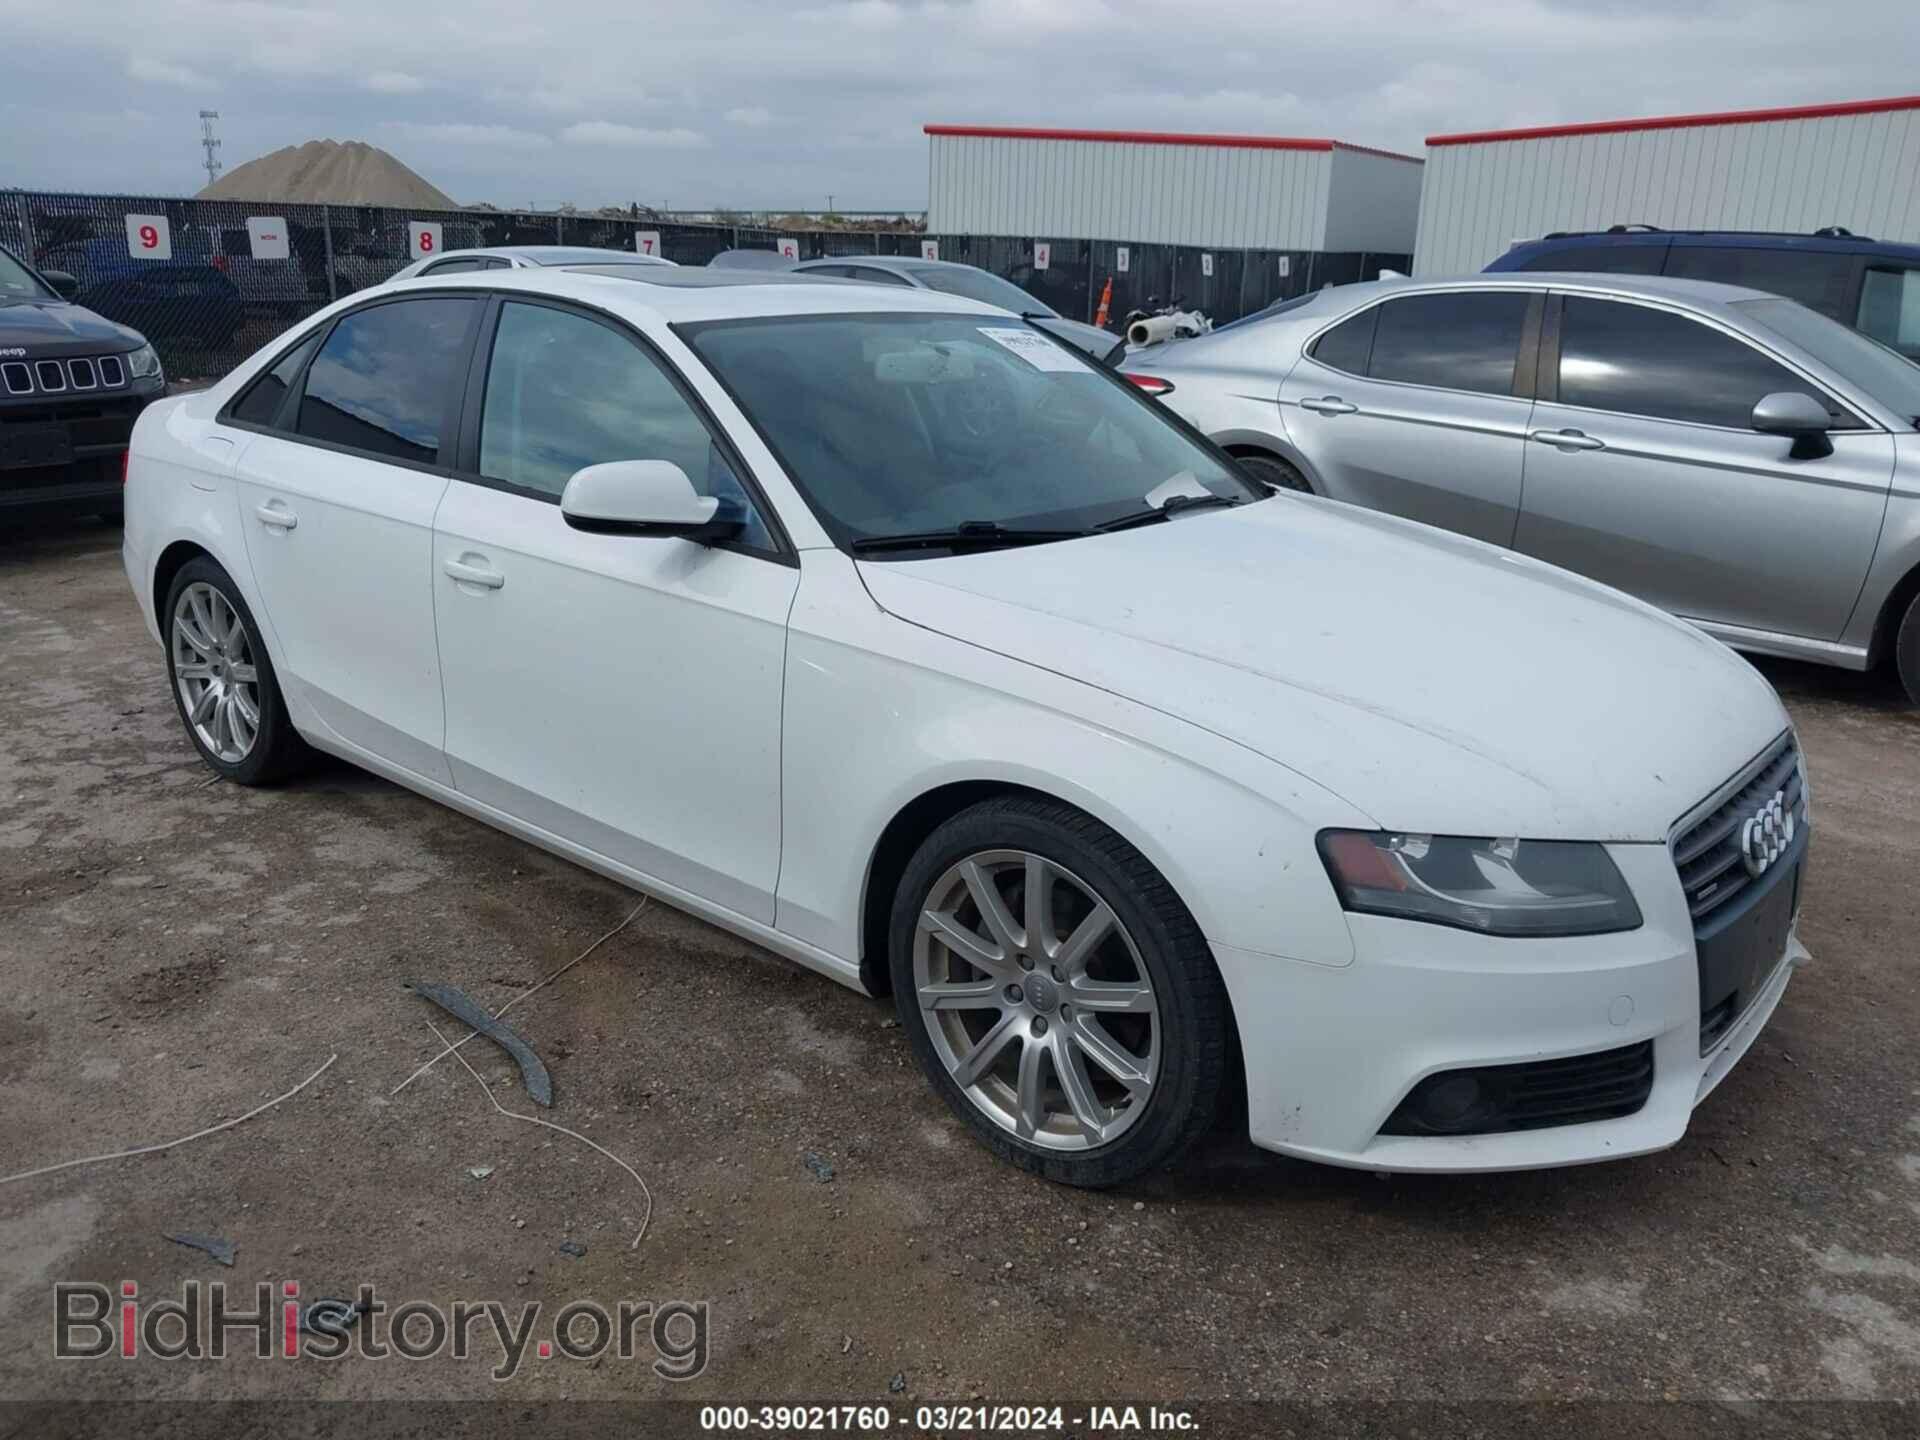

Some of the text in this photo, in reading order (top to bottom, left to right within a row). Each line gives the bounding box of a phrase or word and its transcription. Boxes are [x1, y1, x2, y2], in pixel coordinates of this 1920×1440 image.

[139, 225, 158, 248] 9
[420, 231, 433, 251] 8
[642, 239, 653, 255] 7
[784, 245, 794, 259] 6
[927, 247, 935, 261] 5
[1038, 249, 1046, 263] 4
